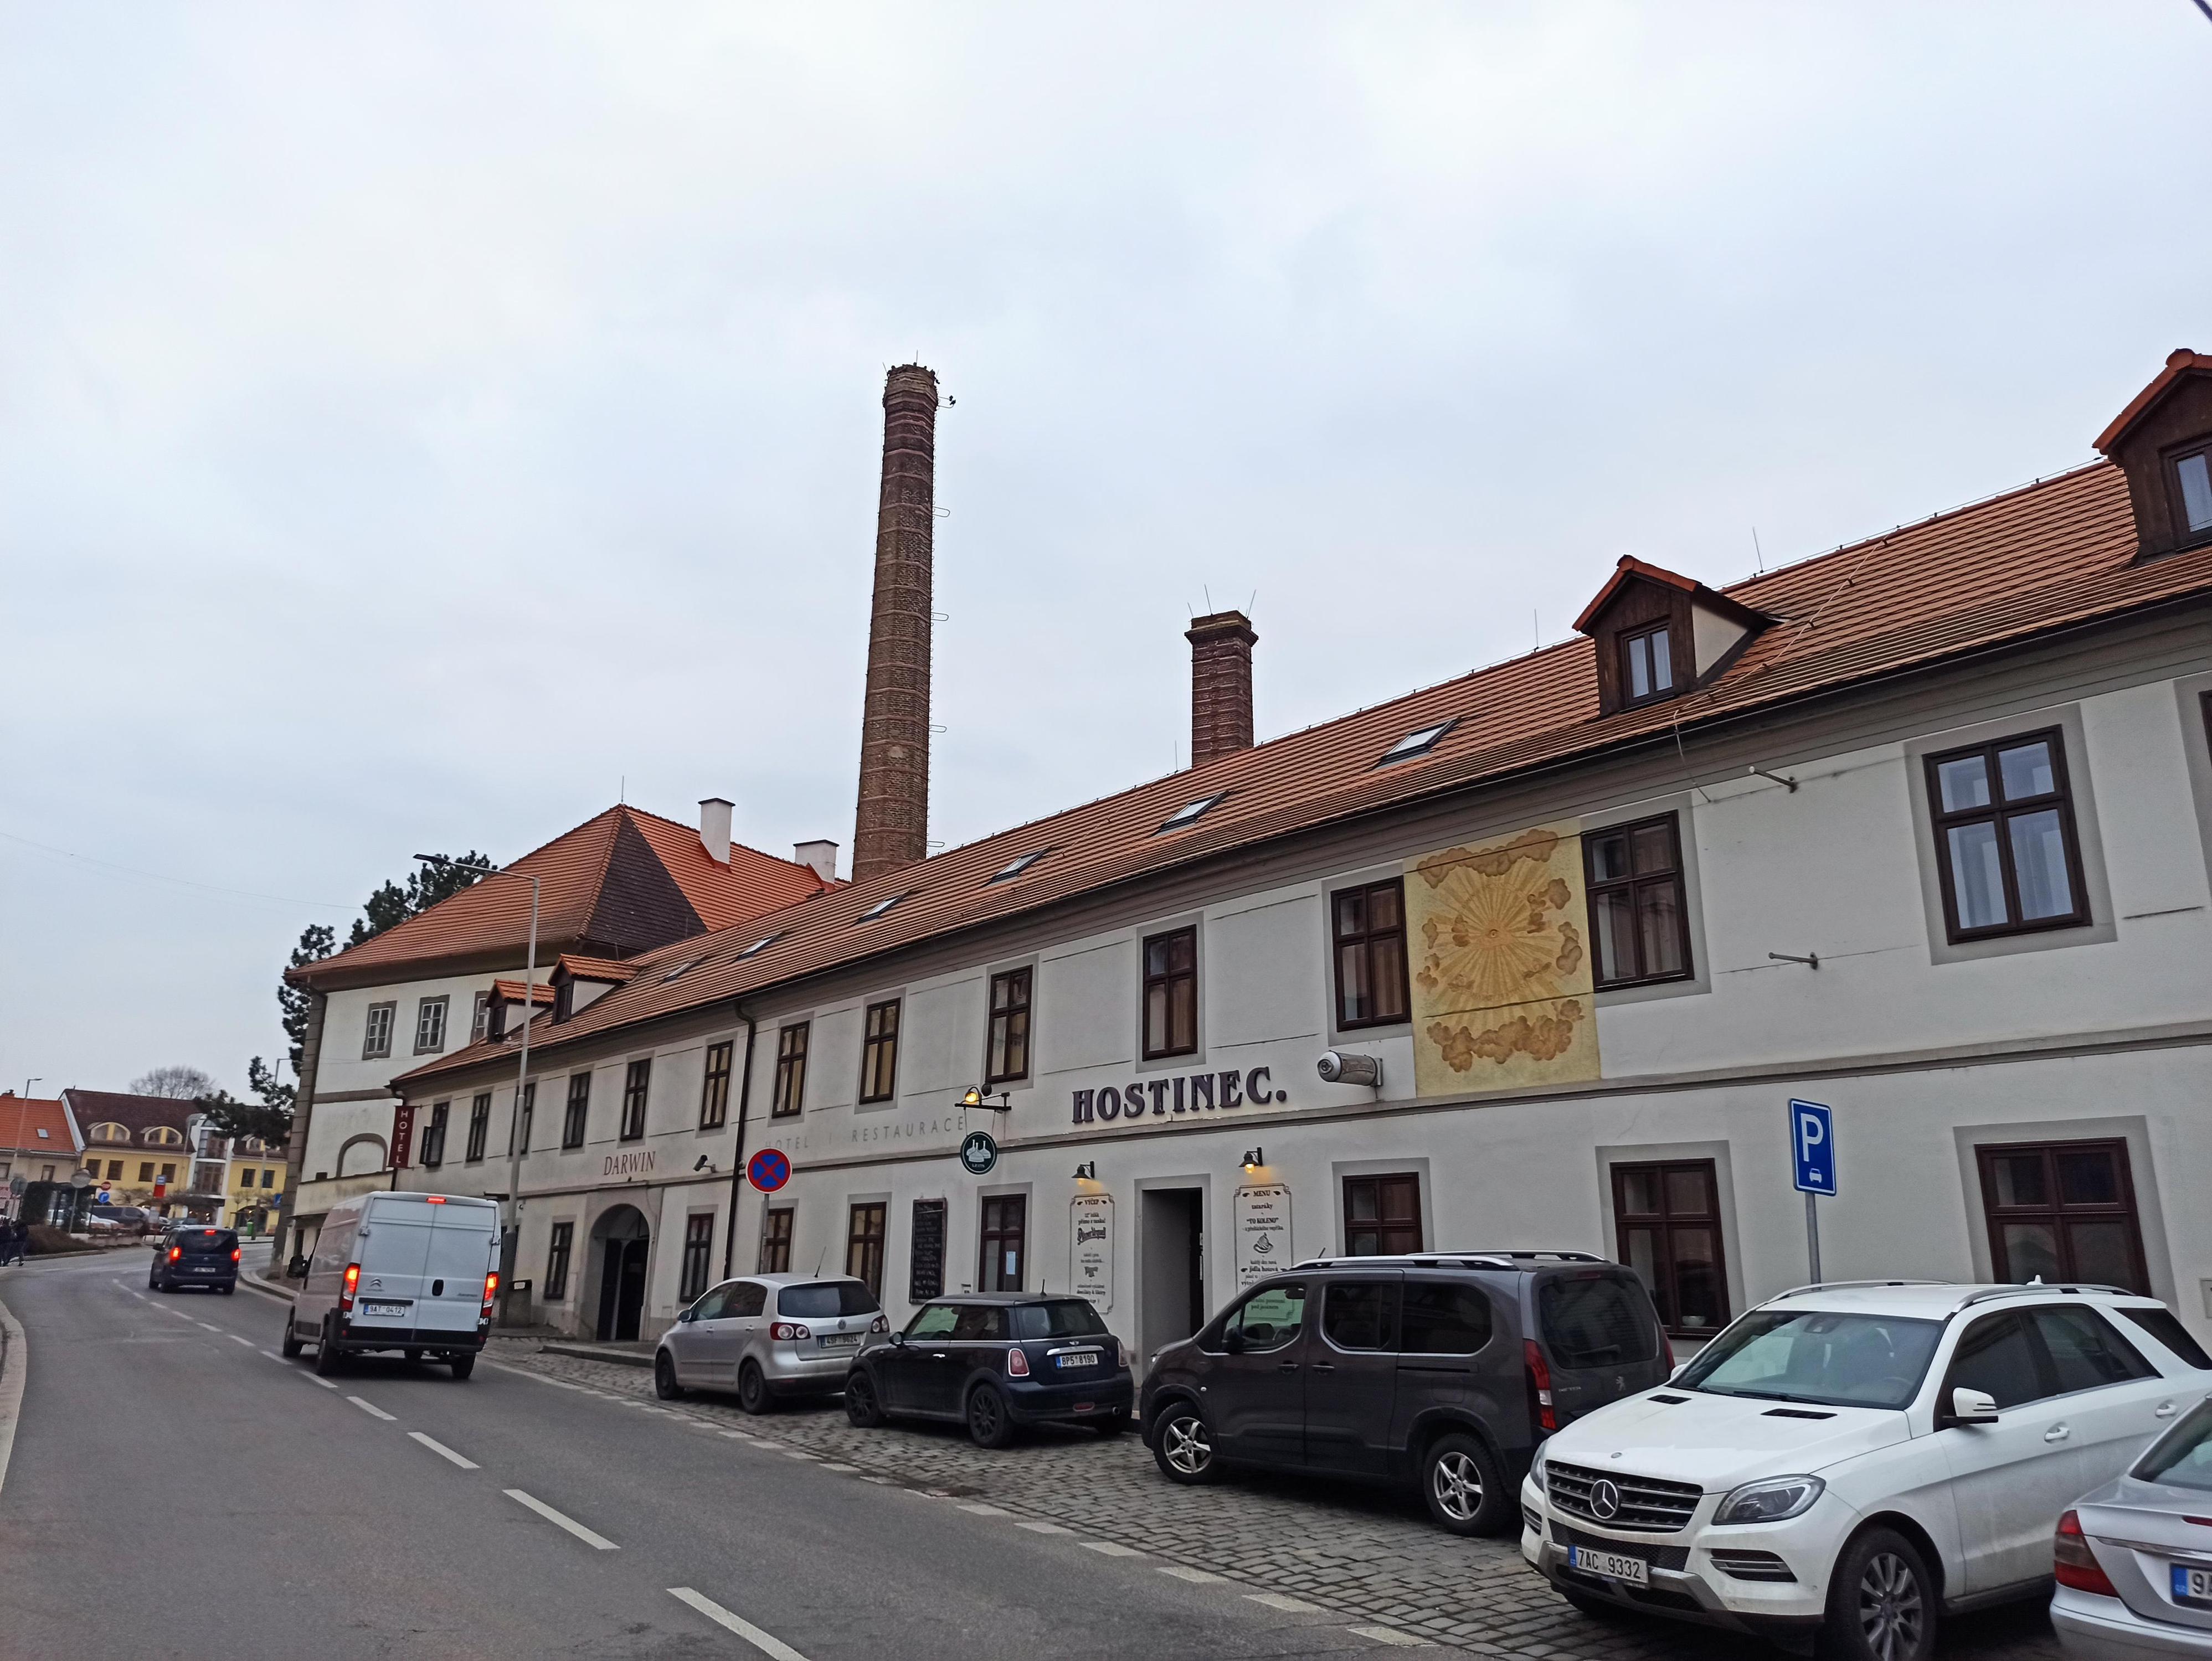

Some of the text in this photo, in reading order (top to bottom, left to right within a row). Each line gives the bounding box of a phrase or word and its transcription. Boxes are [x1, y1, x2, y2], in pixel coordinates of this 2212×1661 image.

[1072, 1066, 1287, 1123] HOSTINEC.
[395, 1111, 408, 1163] HOTEL
[852, 1116, 964, 1142] RESTAURACE
[1801, 1113, 1824, 1162] P
[603, 1151, 656, 1175] DARWIN
[1062, 1356, 1075, 1365] 8P5
[1079, 1354, 1095, 1364] 8190
[1578, 1550, 1641, 1579] 7AC 9332
